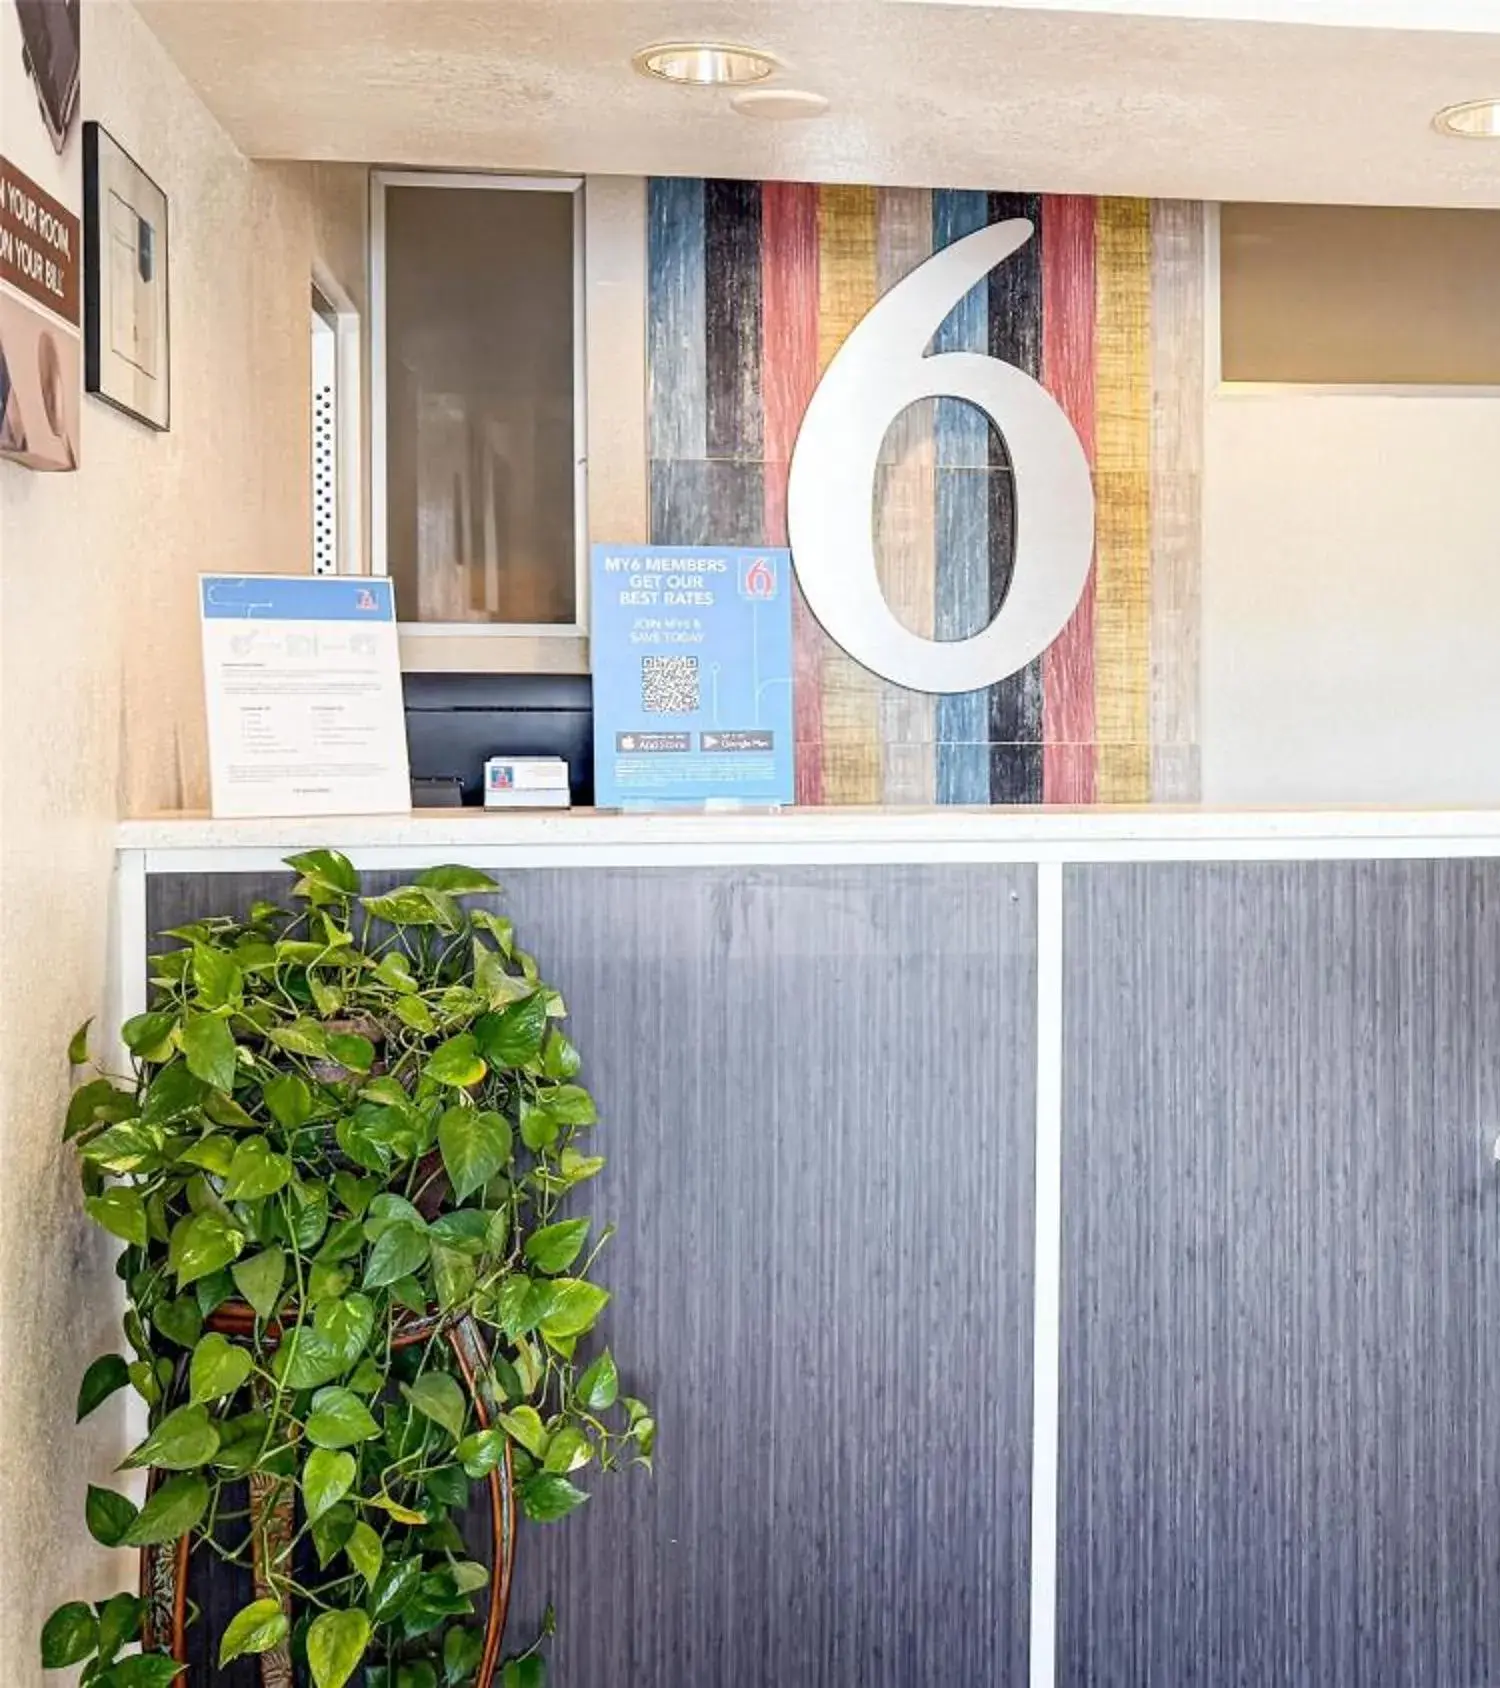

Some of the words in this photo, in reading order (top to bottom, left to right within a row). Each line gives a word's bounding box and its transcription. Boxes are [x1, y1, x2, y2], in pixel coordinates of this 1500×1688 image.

[8, 181, 38, 232] YOUR
[15, 236, 43, 282] YOUR
[787, 217, 1095, 695] 6
[604, 556, 641, 573] MY6
[645, 557, 728, 573] MEMBERS
[629, 574, 662, 589] GET
[666, 574, 704, 589] OUR
[619, 590, 660, 606] BEST
[664, 591, 714, 606] RATES
[633, 617, 661, 630] JOIN
